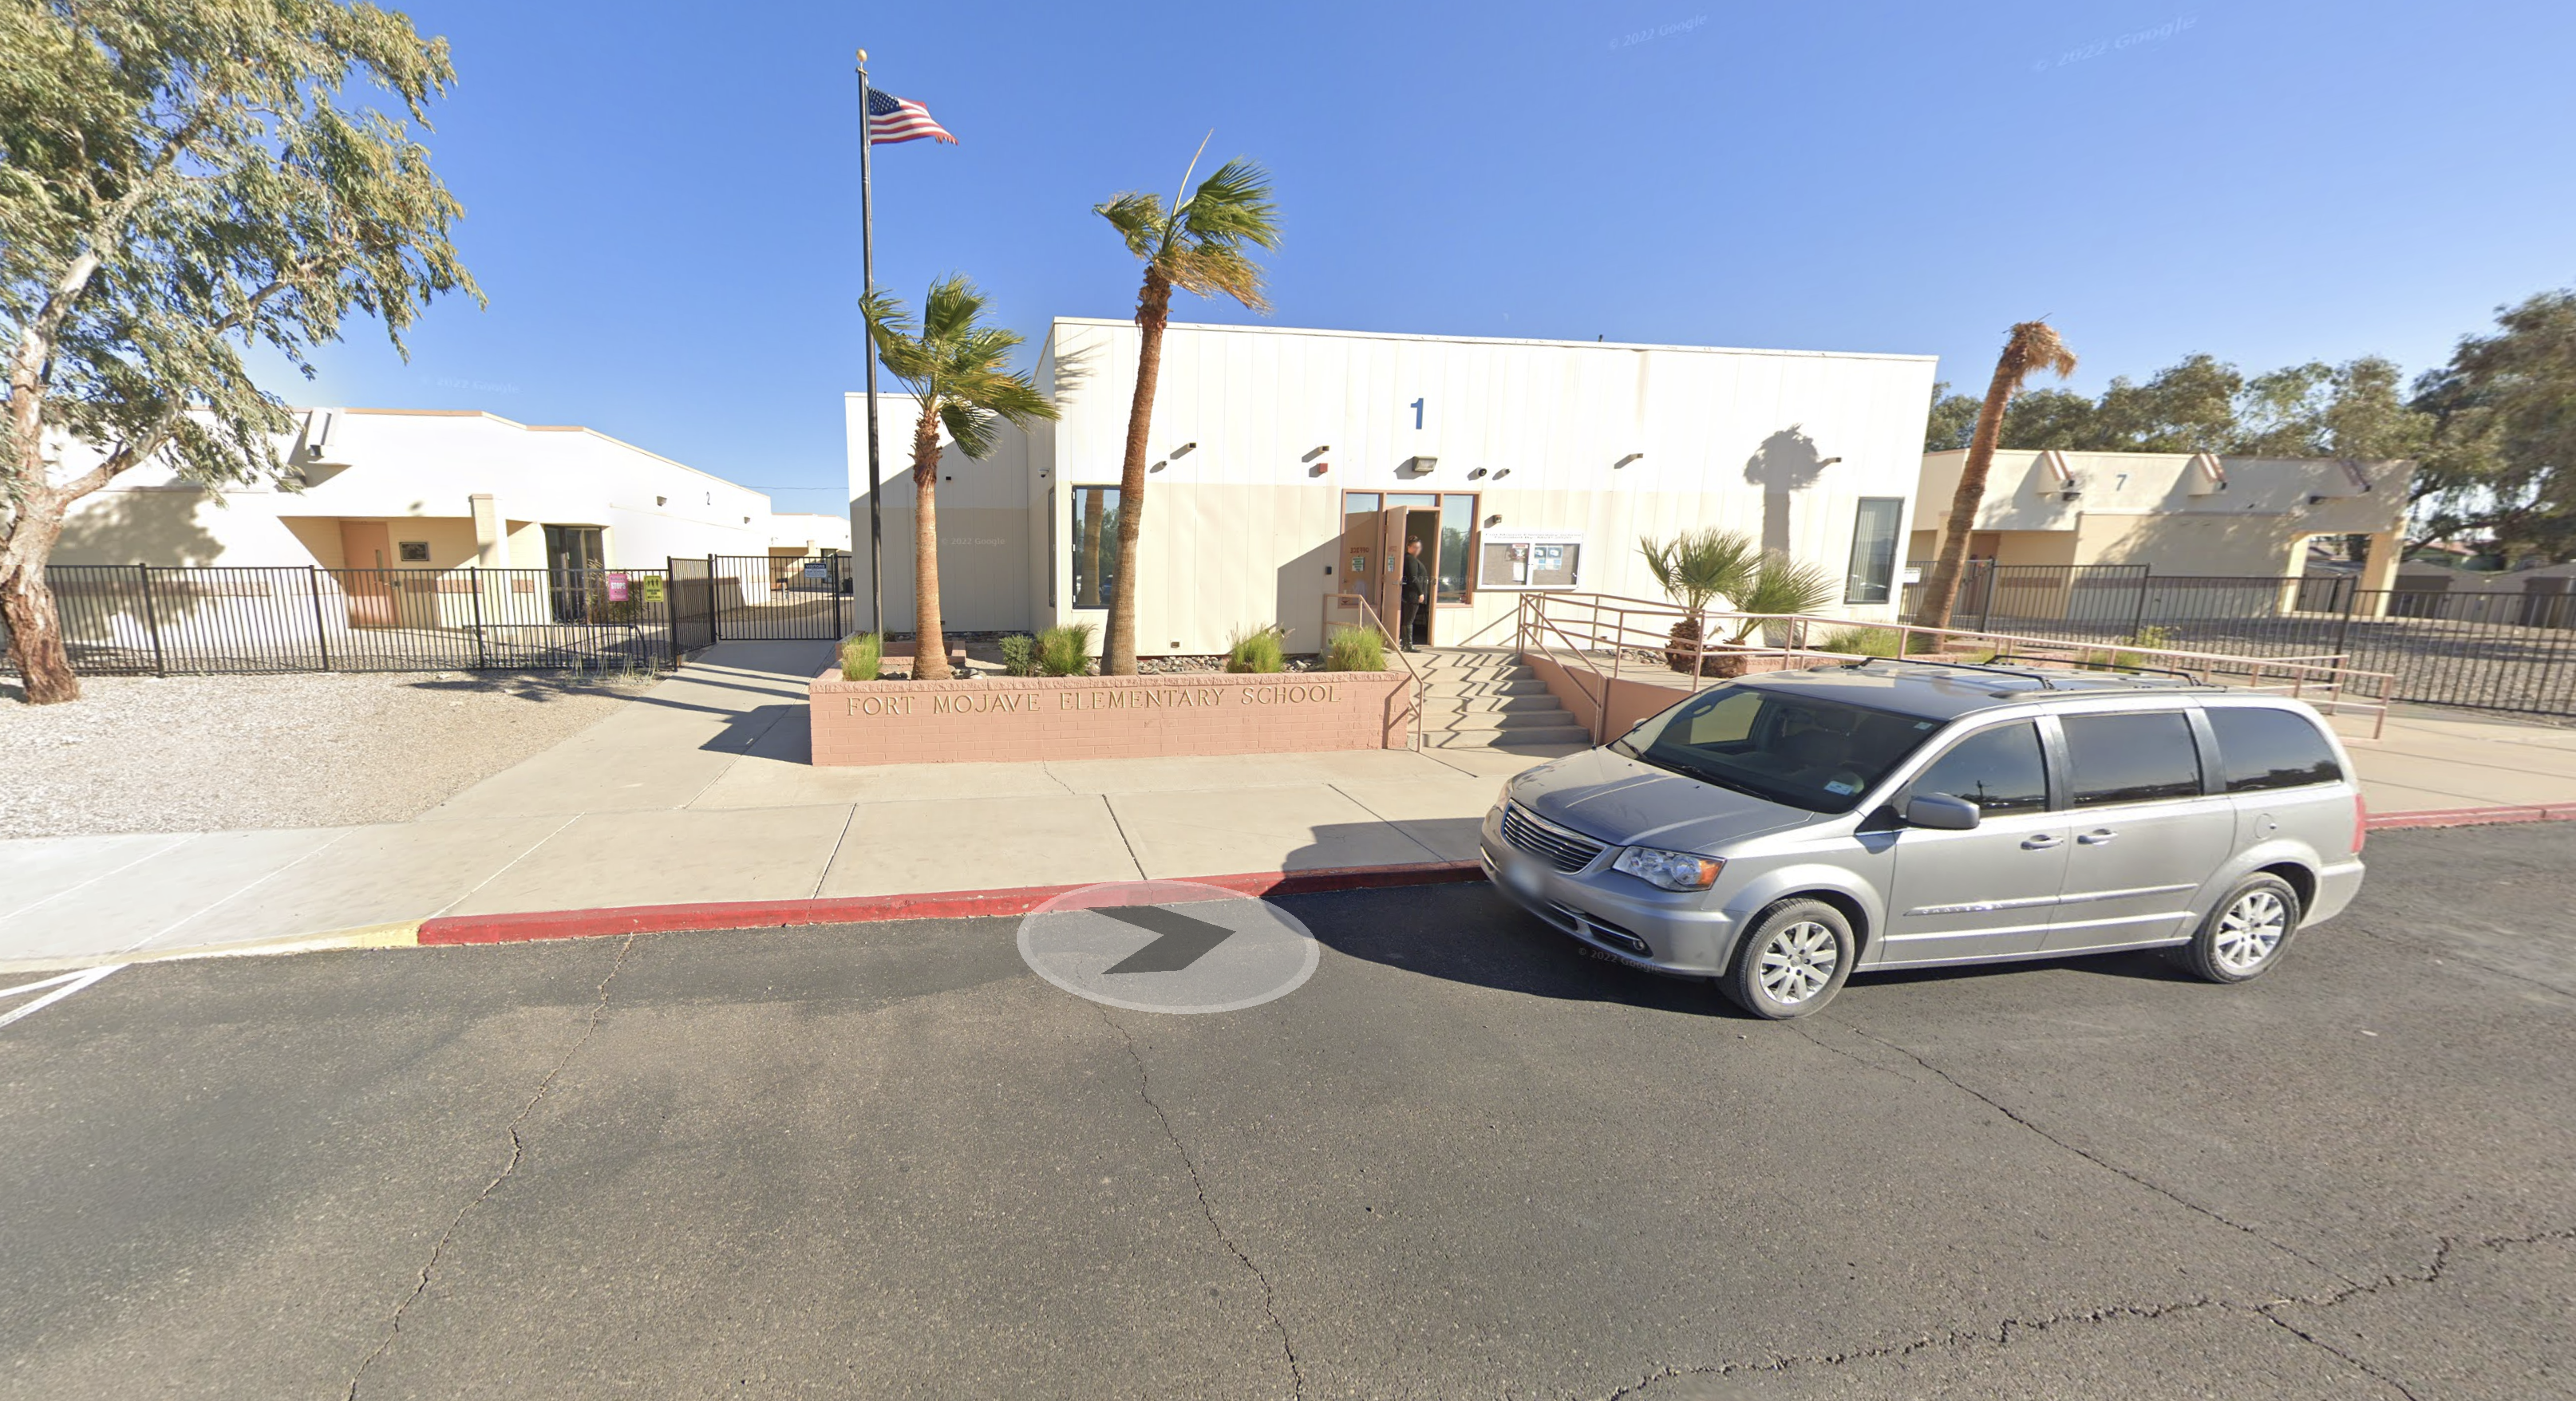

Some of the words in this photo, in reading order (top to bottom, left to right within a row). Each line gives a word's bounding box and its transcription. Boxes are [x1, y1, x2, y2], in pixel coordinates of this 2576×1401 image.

[1410, 397, 1424, 430] 1
[2116, 474, 2127, 491] 7
[706, 491, 710, 505] 2
[847, 696, 915, 716] FORT
[934, 693, 1041, 714] MOJAVE
[1060, 688, 1224, 710] ELEMENTARY
[1241, 685, 1341, 705] SCHOOL
